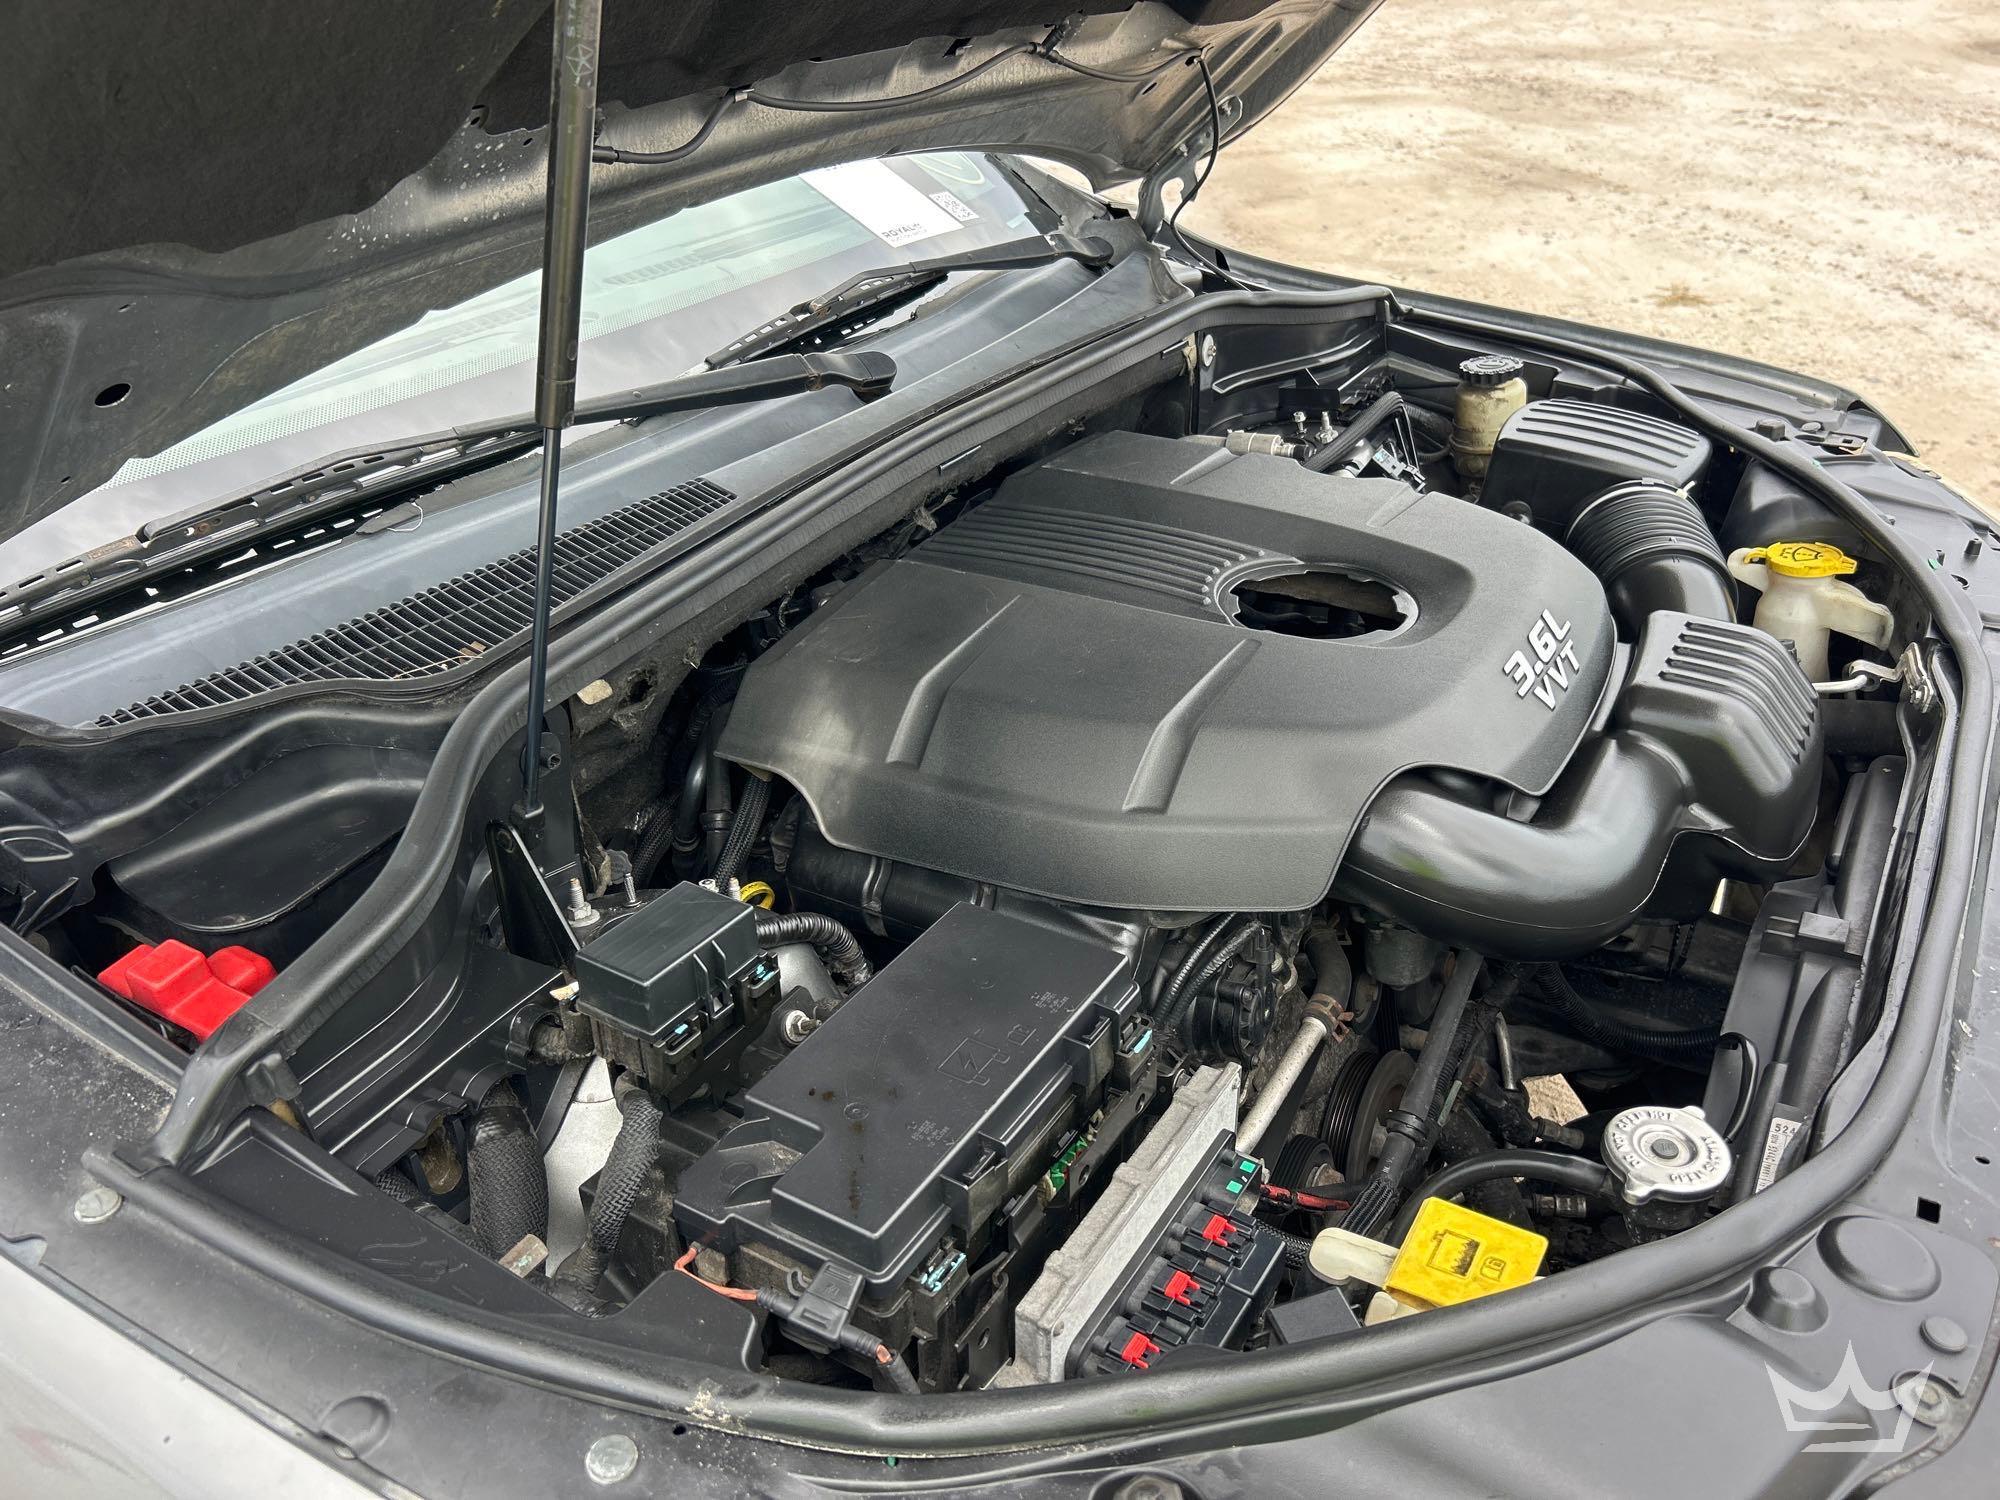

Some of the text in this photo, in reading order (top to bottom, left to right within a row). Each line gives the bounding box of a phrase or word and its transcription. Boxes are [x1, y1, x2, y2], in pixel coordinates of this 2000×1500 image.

[881, 225, 917, 238] ROYAL
[1502, 608, 1571, 698] 3.6L
[1533, 639, 1580, 711] VVT
